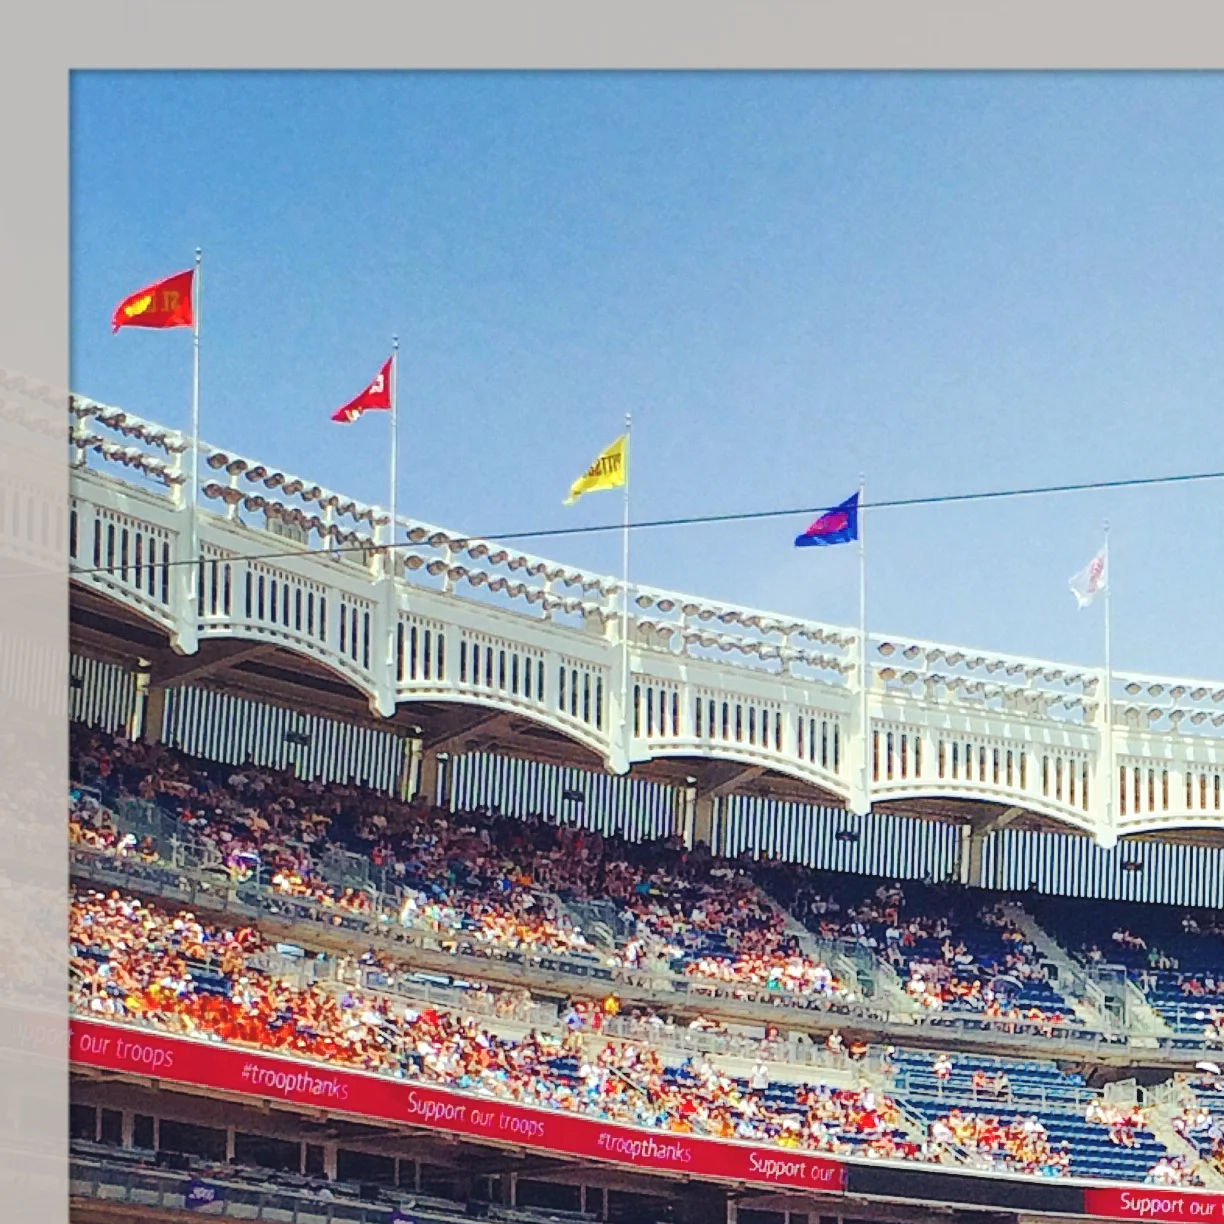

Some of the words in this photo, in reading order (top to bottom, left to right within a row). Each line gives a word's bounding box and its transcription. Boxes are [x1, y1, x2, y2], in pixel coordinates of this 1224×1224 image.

[80, 1034, 111, 1056] our
[116, 1037, 174, 1068] troops
[241, 1062, 349, 1100] #troopthanks
[408, 1090, 467, 1123] Support
[471, 1108, 495, 1127] our
[499, 1112, 545, 1138] troops
[597, 1131, 692, 1164] #troopthanks
[749, 1153, 807, 1180] Support
[811, 1165, 836, 1181] our
[1120, 1192, 1185, 1217] Support
[1189, 1201, 1215, 1216] our
